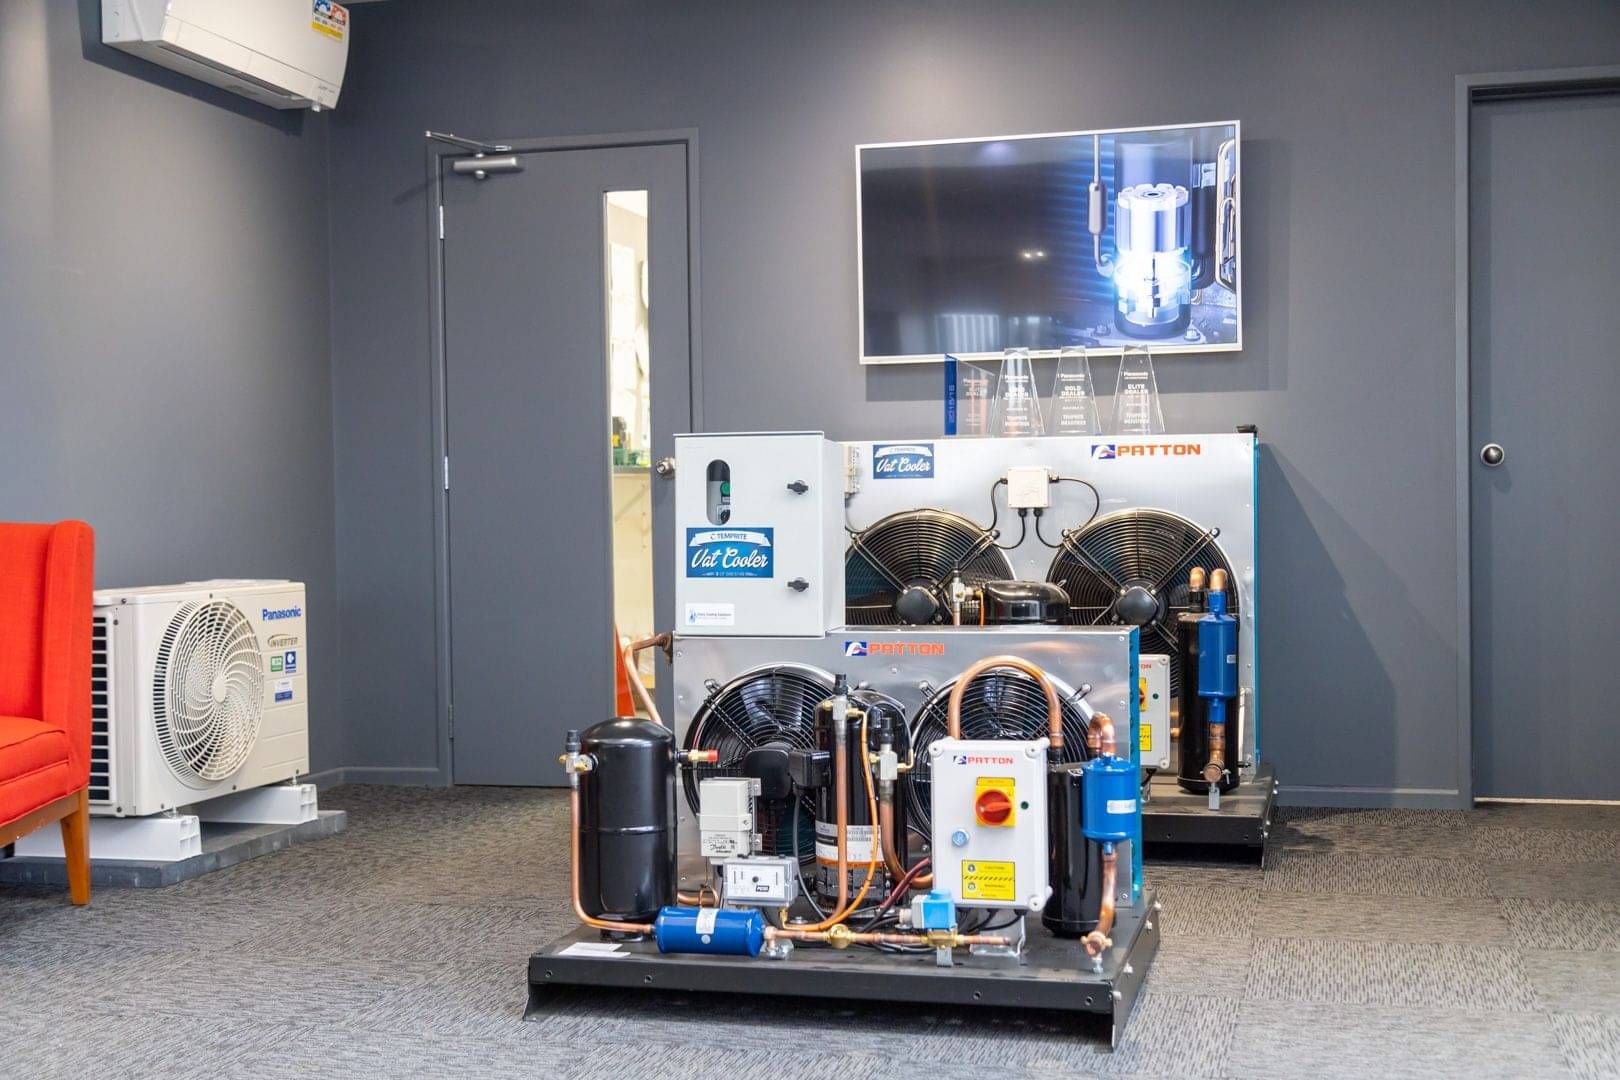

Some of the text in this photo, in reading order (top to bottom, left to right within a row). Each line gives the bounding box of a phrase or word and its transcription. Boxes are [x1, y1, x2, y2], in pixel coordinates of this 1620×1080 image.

[1117, 444, 1201, 456] PATTON
[876, 457, 930, 473] Vat Cooler
[691, 547, 769, 568] Vat Cooler
[262, 605, 301, 621] Panasonic
[271, 638, 298, 648] INVERTER
[868, 642, 945, 656] PATTON
[968, 756, 1014, 765] PATTON
